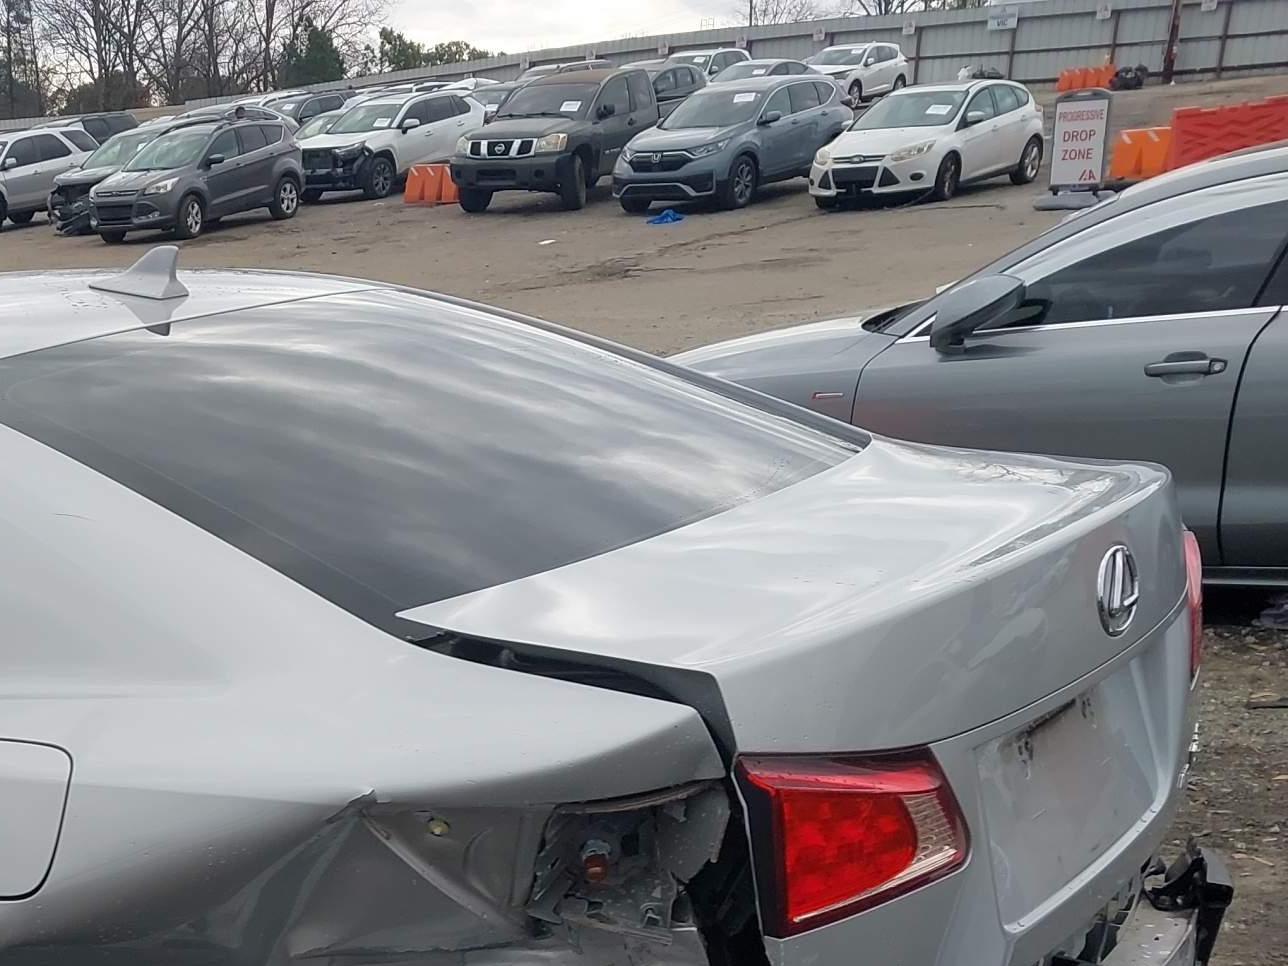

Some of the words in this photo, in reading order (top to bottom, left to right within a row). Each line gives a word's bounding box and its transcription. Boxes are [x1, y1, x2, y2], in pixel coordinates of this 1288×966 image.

[1058, 109, 1105, 121] PROGRESSIVE
[1063, 129, 1097, 142] DROP
[1061, 148, 1094, 161] ZONE
